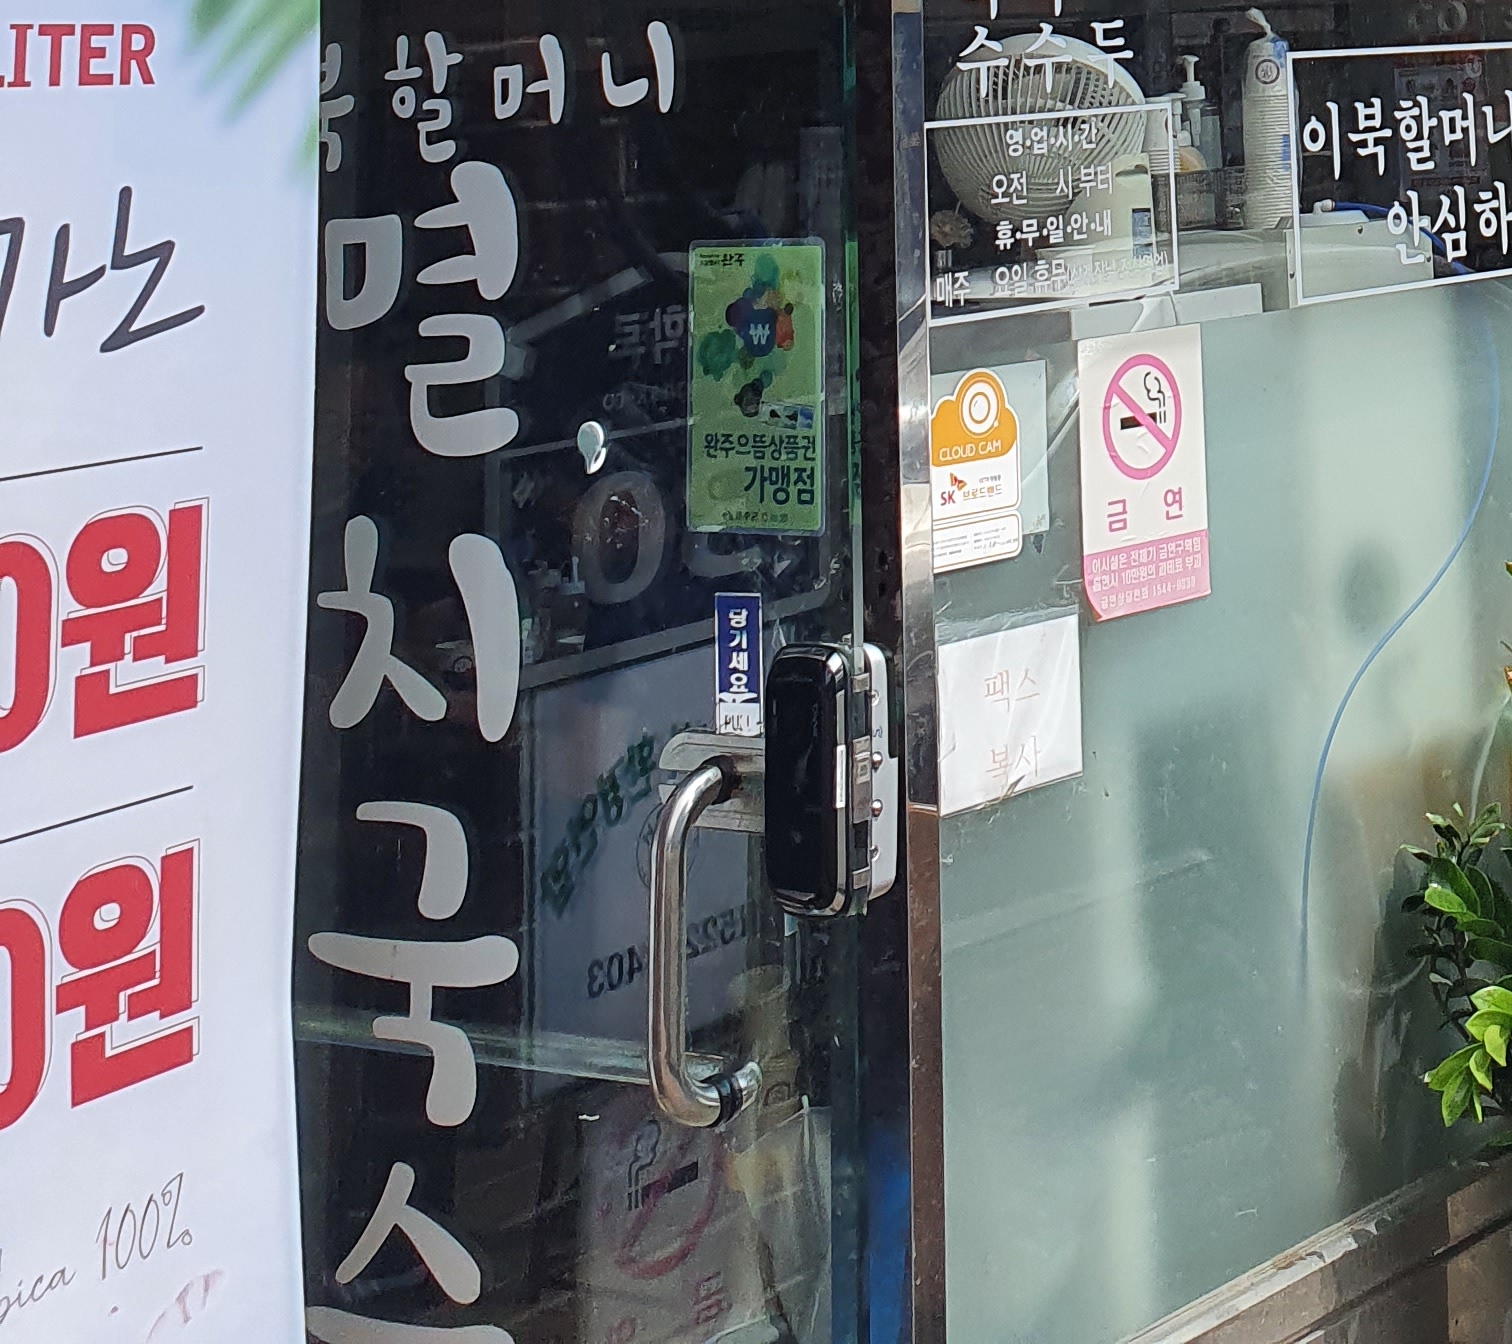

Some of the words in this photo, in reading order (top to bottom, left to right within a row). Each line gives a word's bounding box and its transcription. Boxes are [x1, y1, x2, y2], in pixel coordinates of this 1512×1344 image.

[0, 23, 156, 88] ITER
[990, 171, 1028, 206] 오전
[1056, 166, 1073, 200] 시
[1079, 162, 1114, 197] 부터
[936, 271, 972, 308] 매주
[995, 264, 1028, 296] 요일
[704, 432, 817, 462] 완주으뜸상품권
[939, 443, 976, 461] CLOUD
[979, 439, 1002, 454] CAM
[743, 464, 815, 506] 가맹점
[940, 489, 957, 506] SK
[727, 607, 749, 694] 당기세요
[984, 668, 1041, 712] 팩스
[95, 1171, 193, 1281] 100%
